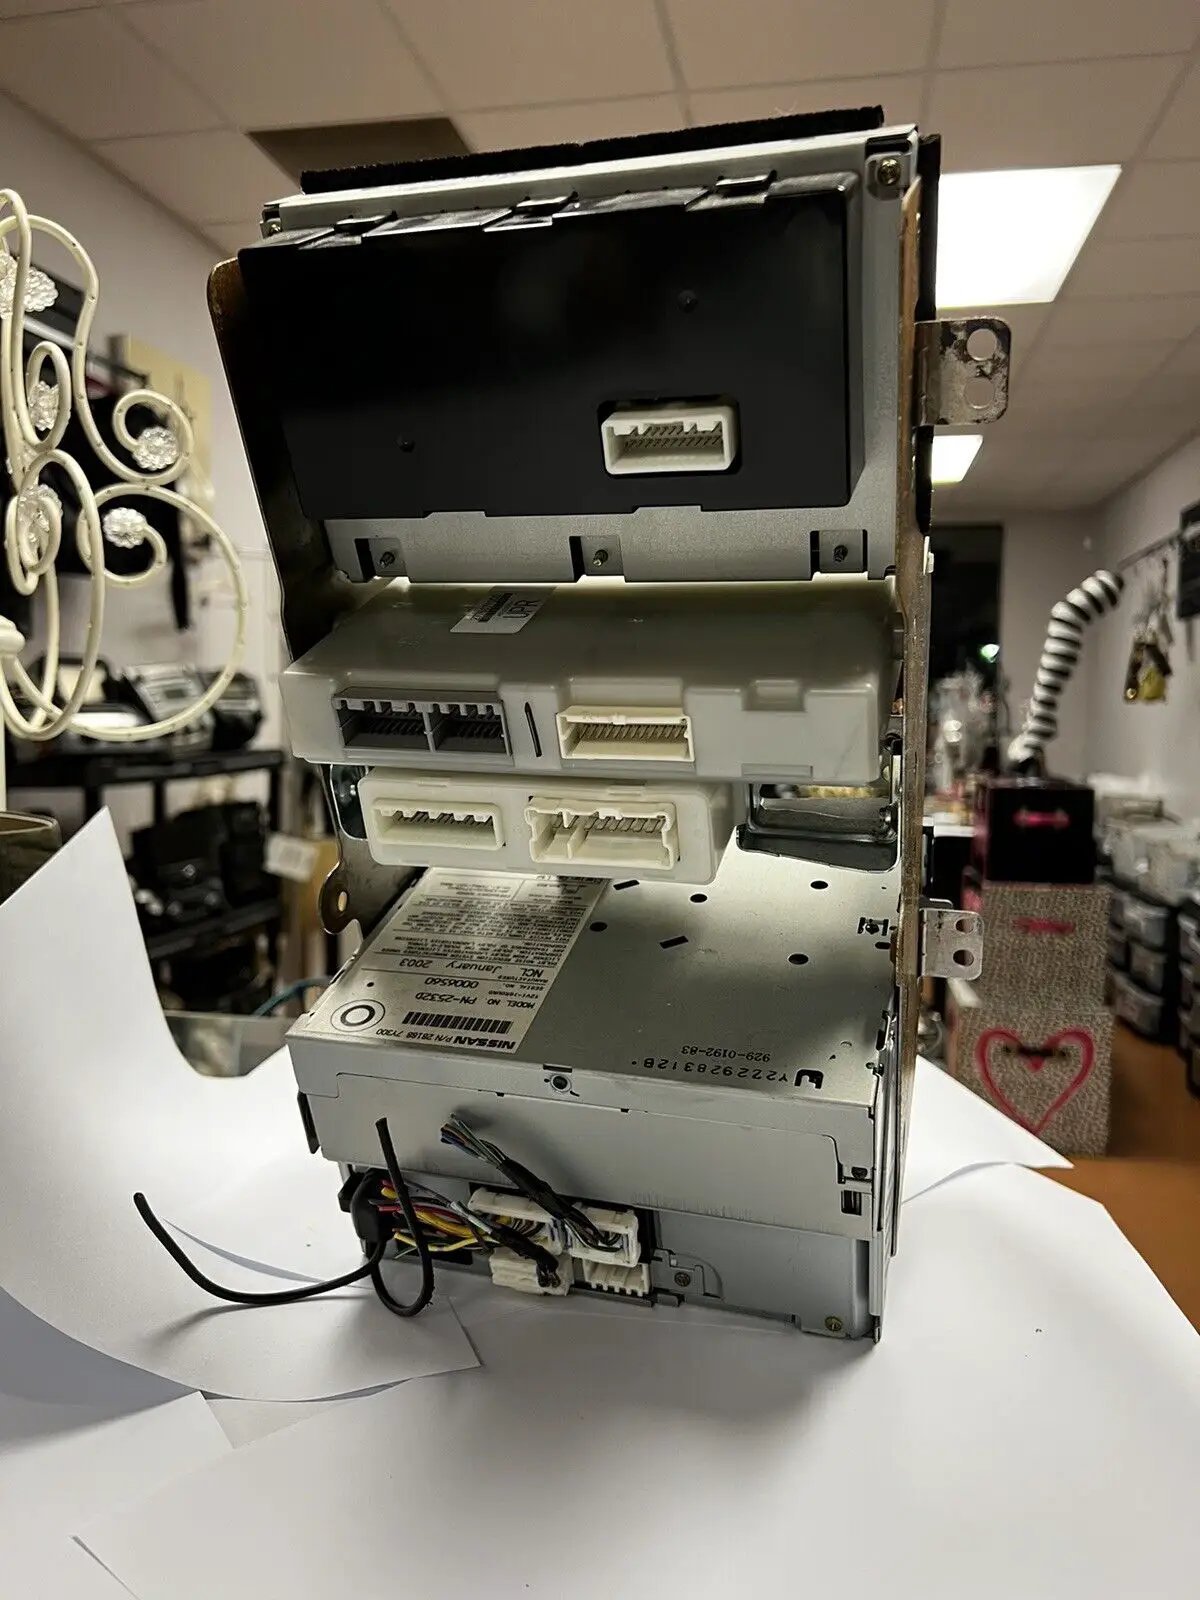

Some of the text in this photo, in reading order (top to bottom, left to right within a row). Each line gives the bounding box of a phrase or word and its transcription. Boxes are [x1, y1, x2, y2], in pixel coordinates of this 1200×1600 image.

[398, 958, 544, 977] NCL January 2003
[423, 976, 480, 988] 0006560
[413, 991, 477, 1004] PN-2532D
[504, 999, 535, 1008] MODEL
[374, 1028, 404, 1036] 7Y300
[433, 1034, 453, 1042] P/N
[452, 1035, 516, 1049] NISSAN
[681, 1045, 770, 1063] 929-0192-83
[643, 1057, 788, 1083] Y222928312B
